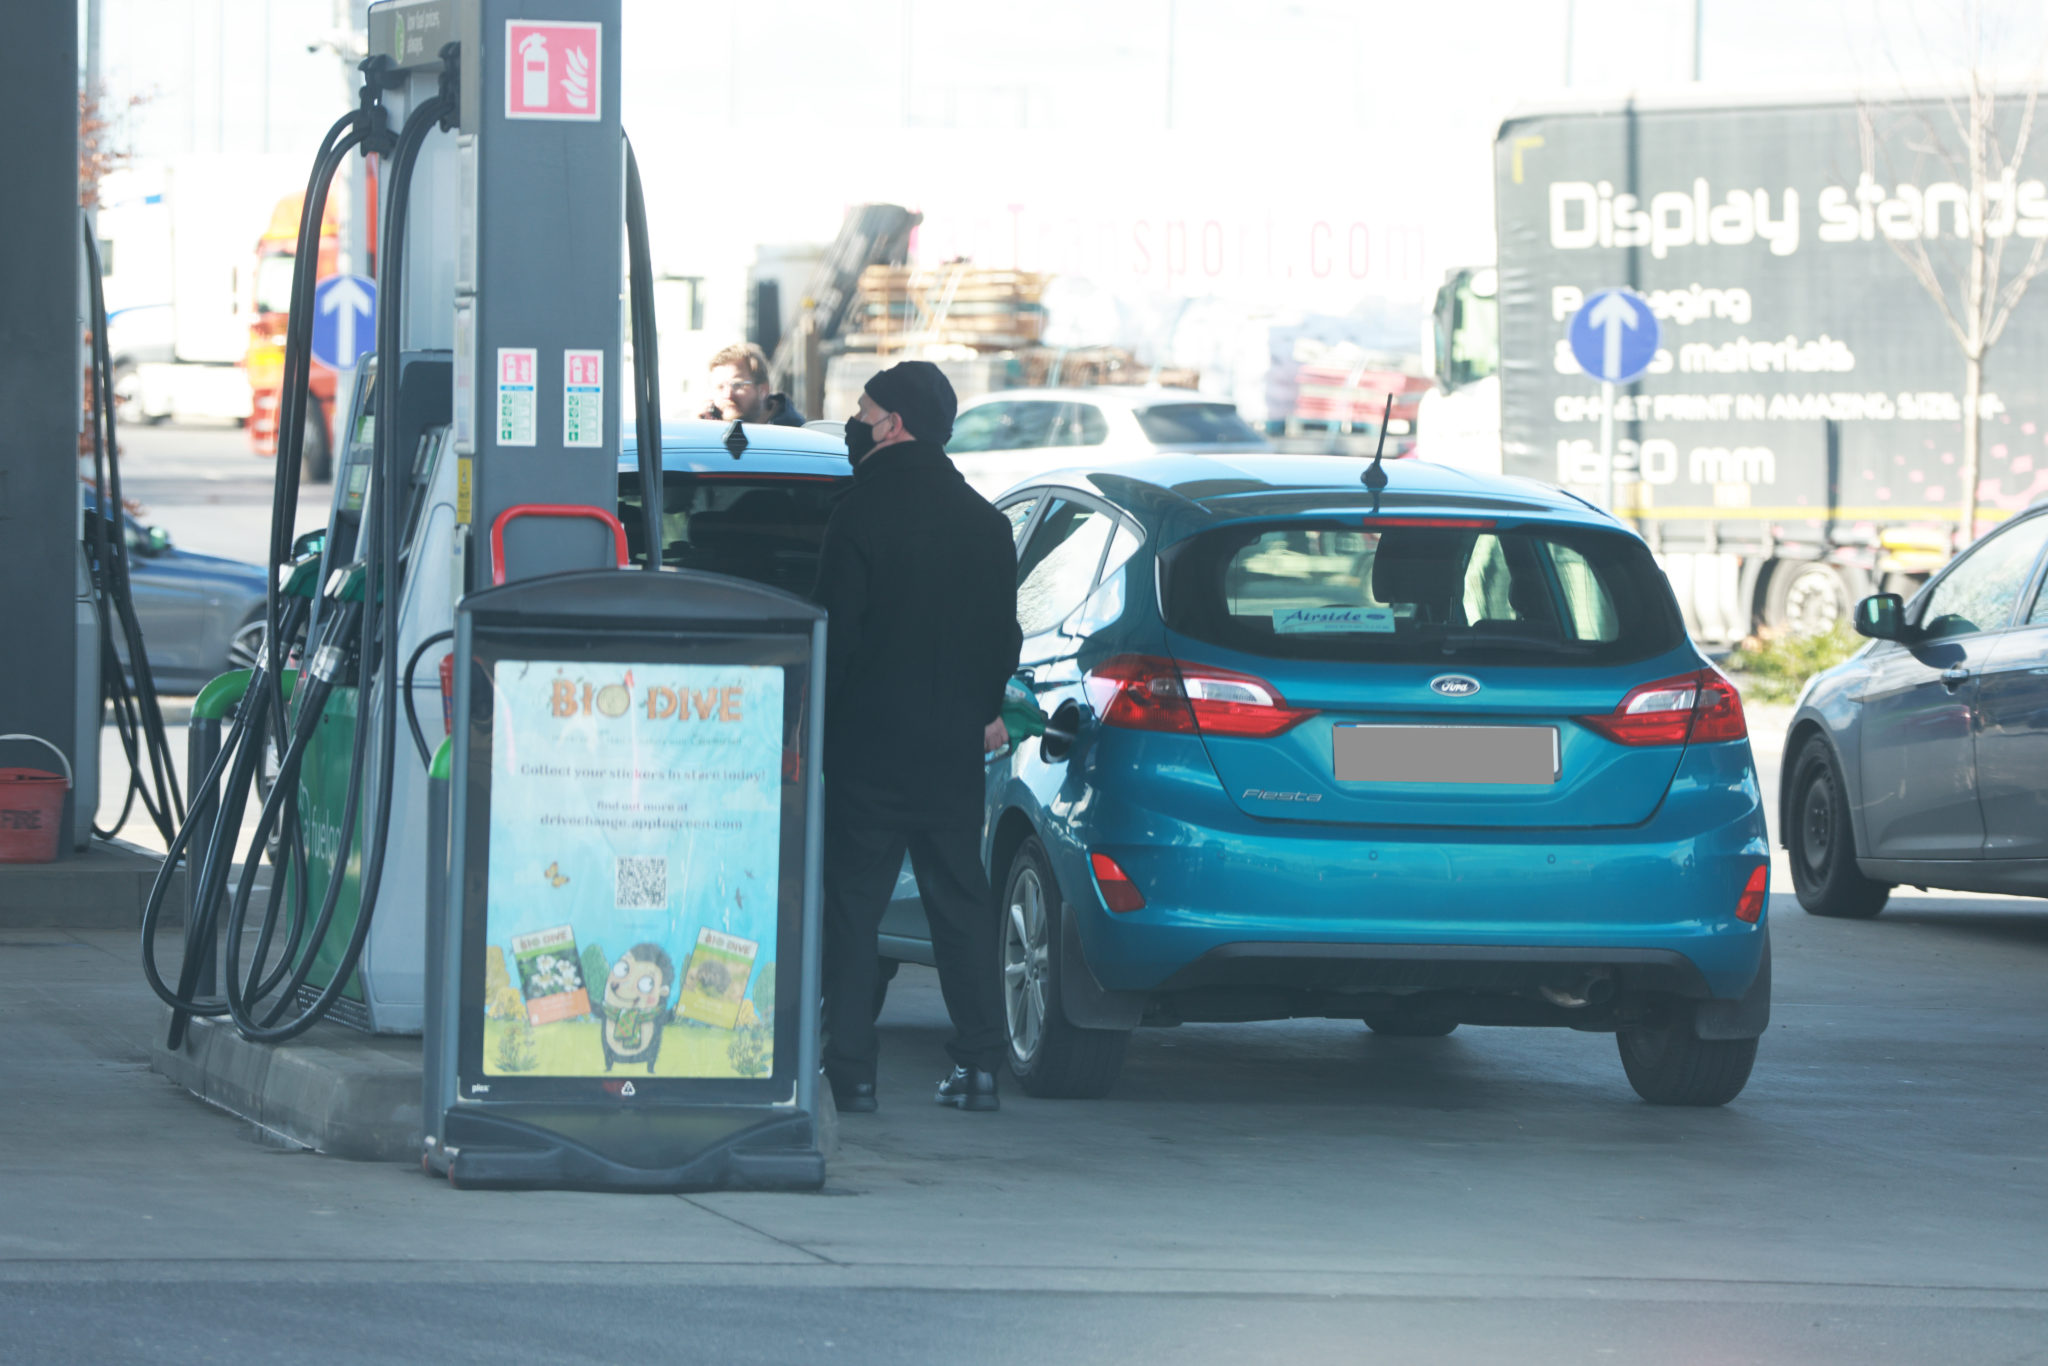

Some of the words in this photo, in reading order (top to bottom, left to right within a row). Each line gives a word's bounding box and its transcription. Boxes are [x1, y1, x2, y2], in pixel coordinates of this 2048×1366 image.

[1549, 178, 1799, 259] Display
[1818, 167, 2048, 241] stands
[1679, 334, 1855, 374] materials
[1653, 393, 1733, 421] PRINT
[1735, 393, 1766, 421] IN
[1767, 391, 1895, 421] AMAZING
[1689, 446, 1776, 485] mm
[1282, 610, 1361, 624] Airside
[551, 678, 630, 719] BIO
[647, 685, 743, 722] DIVE
[520, 763, 571, 778] Collect
[574, 768, 607, 779] your
[609, 767, 664, 780] stickers
[724, 770, 766, 783] today!
[597, 800, 618, 811] find
[621, 802, 640, 811] out
[1241, 788, 1322, 802] Fiesta
[1, 809, 43, 829] FIRE
